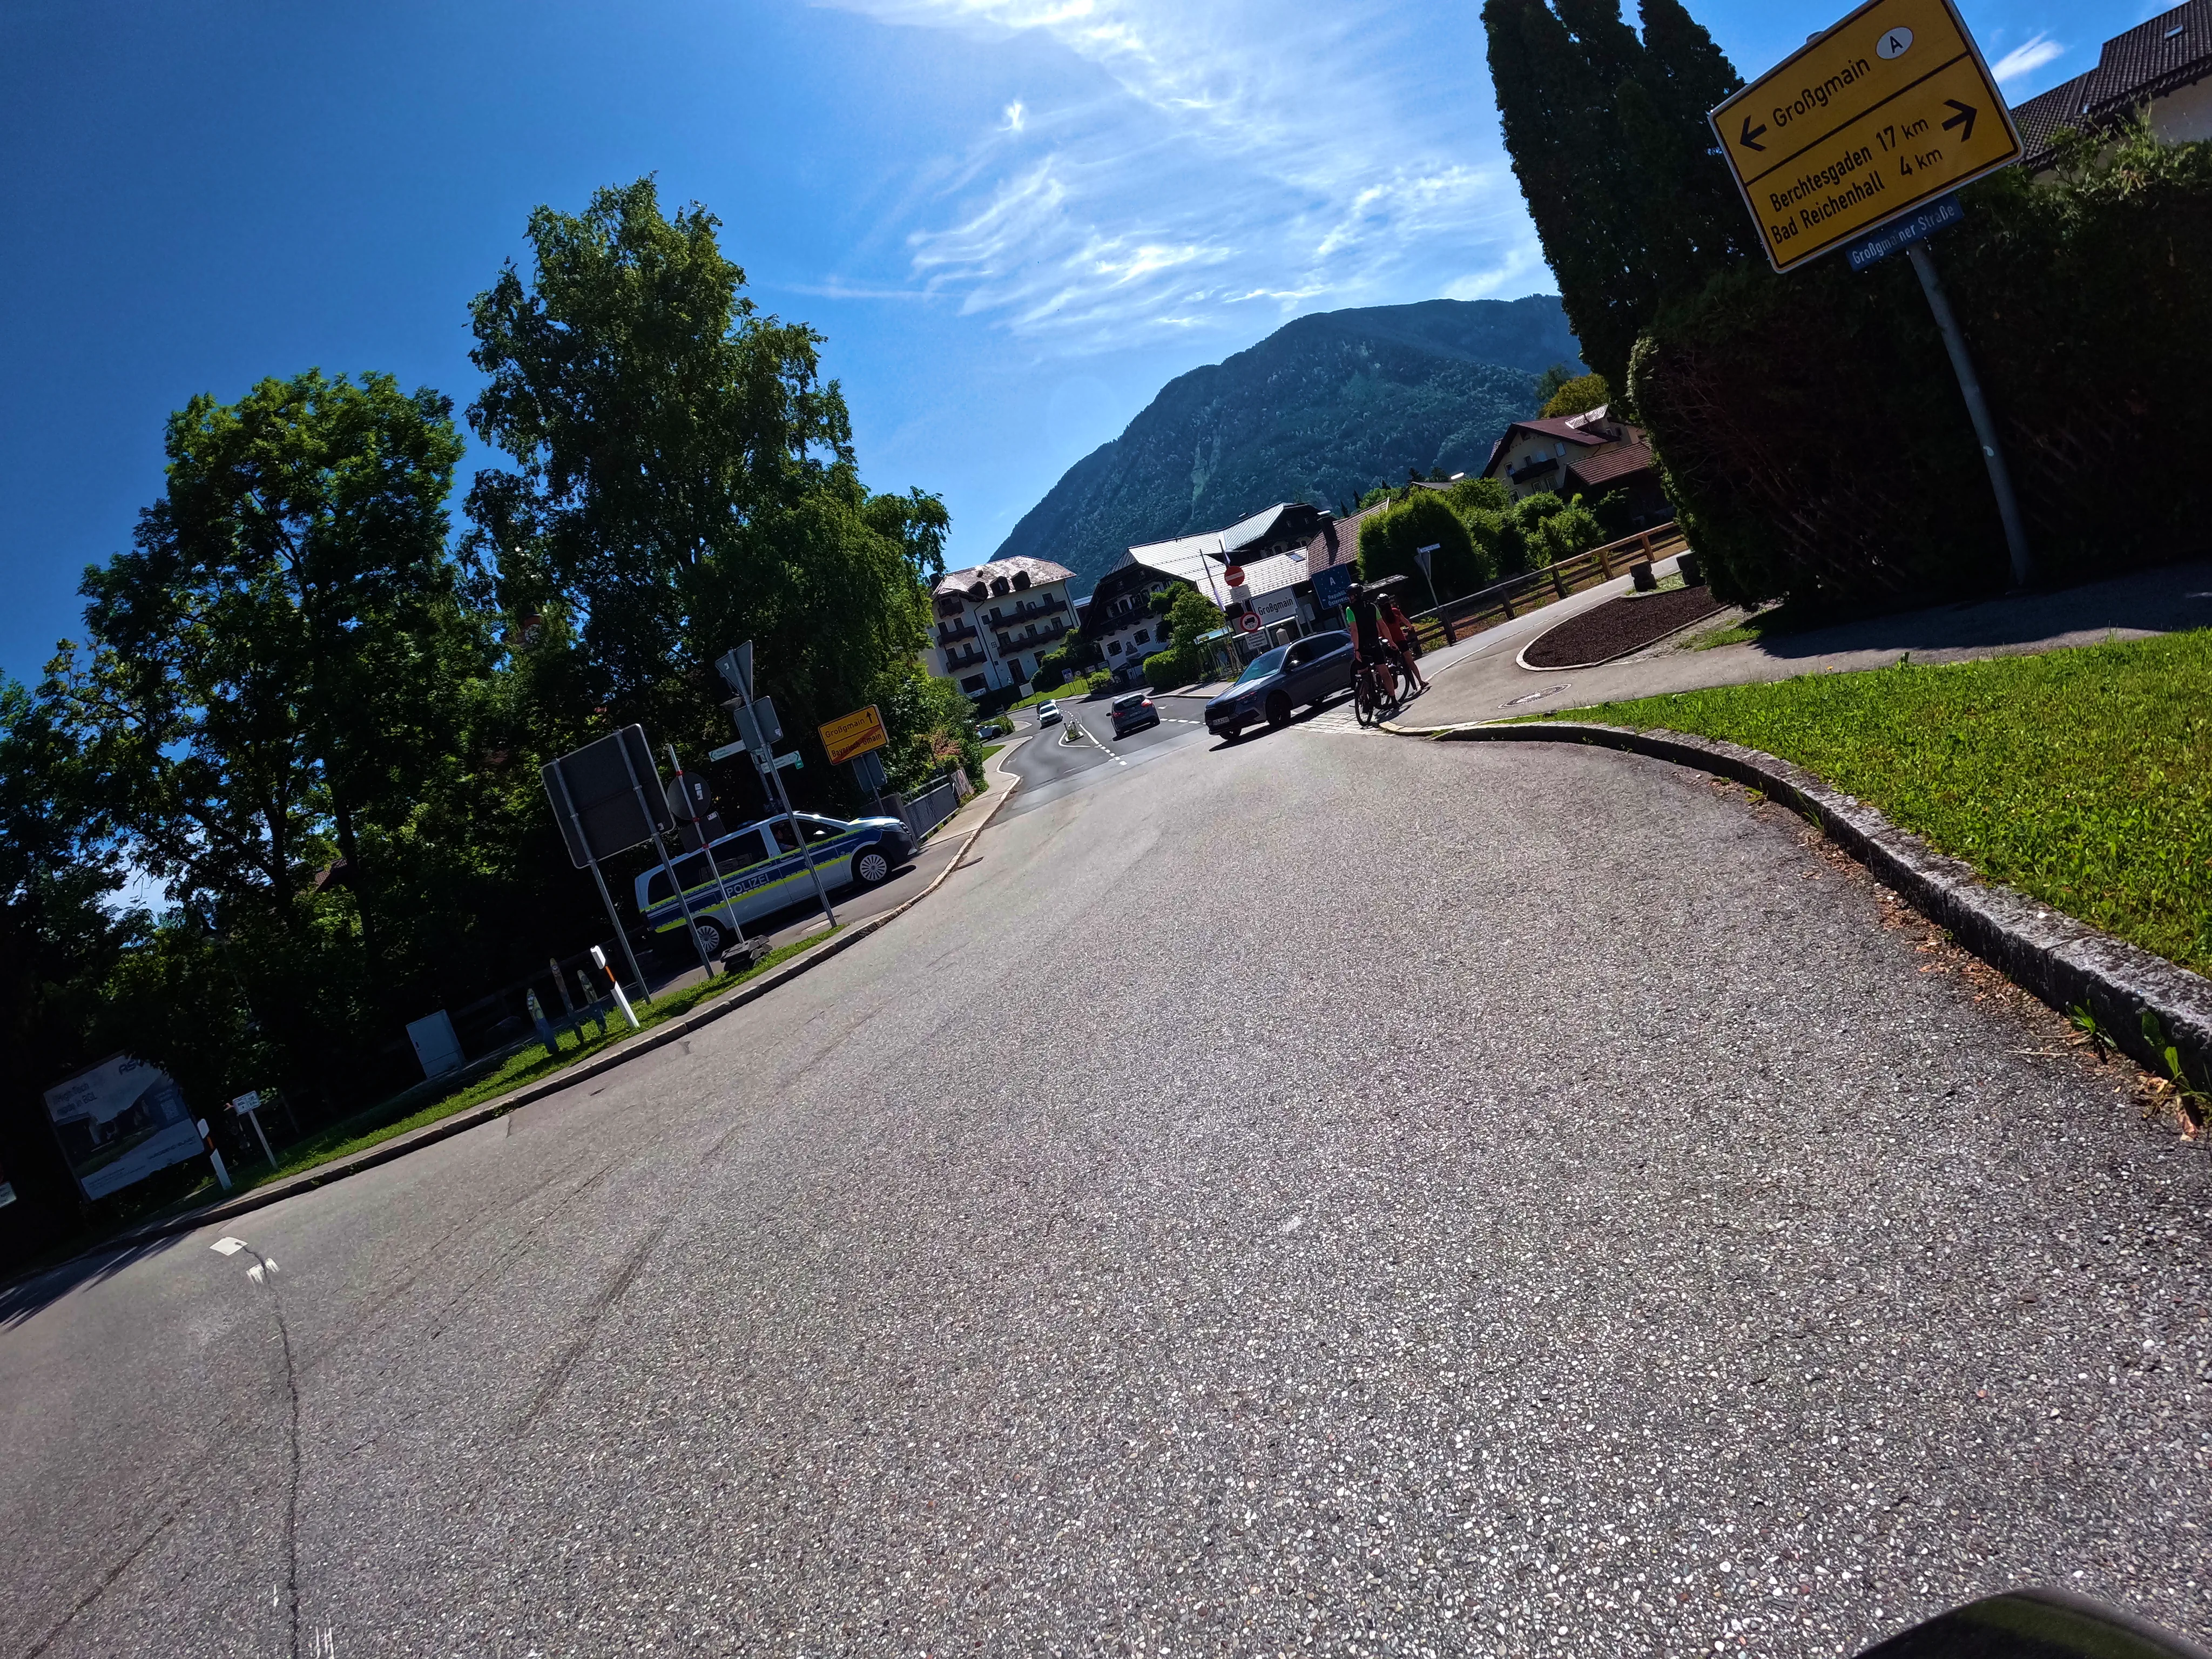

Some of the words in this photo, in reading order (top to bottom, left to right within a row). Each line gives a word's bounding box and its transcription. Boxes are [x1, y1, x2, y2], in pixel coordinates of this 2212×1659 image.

[1890, 36, 1904, 53] A
[1772, 58, 1871, 127] Großgmain
[1769, 146, 1872, 213] Berchtesgaden
[1876, 125, 1896, 152] 17
[1901, 119, 1929, 140] km
[1770, 216, 1799, 244] Bad
[1799, 170, 1885, 229] Reichenhall
[1899, 156, 1913, 176] 4
[1914, 149, 1943, 170] km
[1852, 224, 1916, 264] Großgmaner
[1918, 205, 1955, 231] Straße
[1330, 577, 1336, 585] A
[1258, 597, 1293, 615] Großgmain
[825, 718, 865, 738] Großgmain
[831, 742, 860, 757] Bayerisch
[726, 873, 770, 897] POLIZEI
